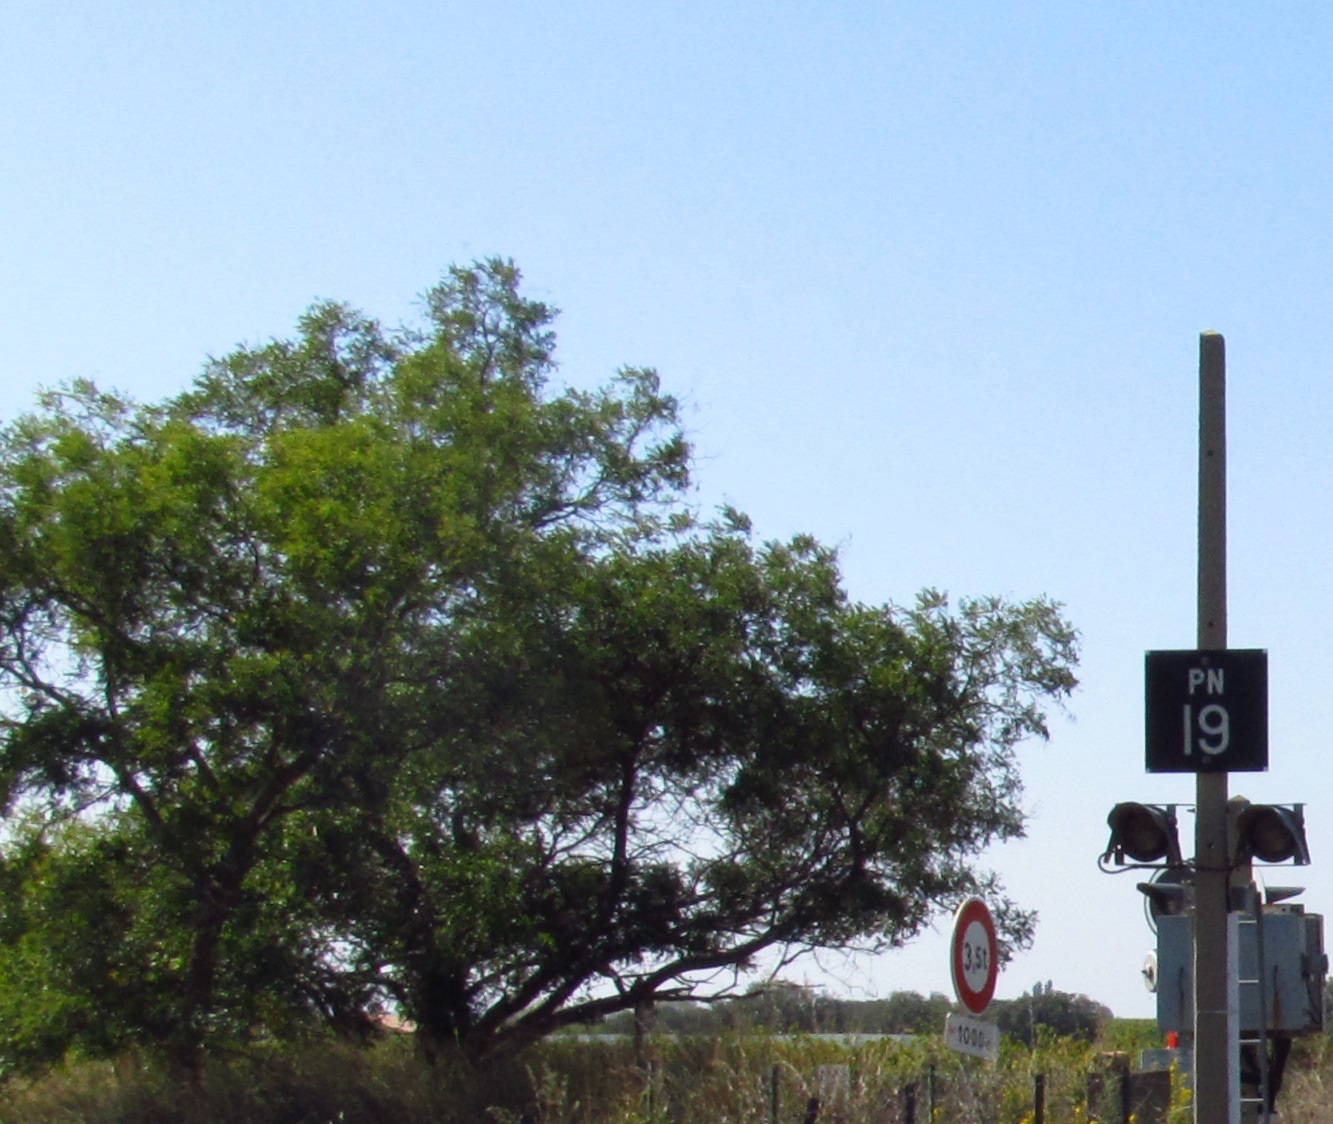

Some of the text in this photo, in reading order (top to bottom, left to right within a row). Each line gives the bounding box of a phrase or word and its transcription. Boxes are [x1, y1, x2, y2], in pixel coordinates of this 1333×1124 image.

[1188, 667, 1224, 695] PN
[1183, 703, 1230, 756] 19
[963, 942, 988, 973] 3,5t
